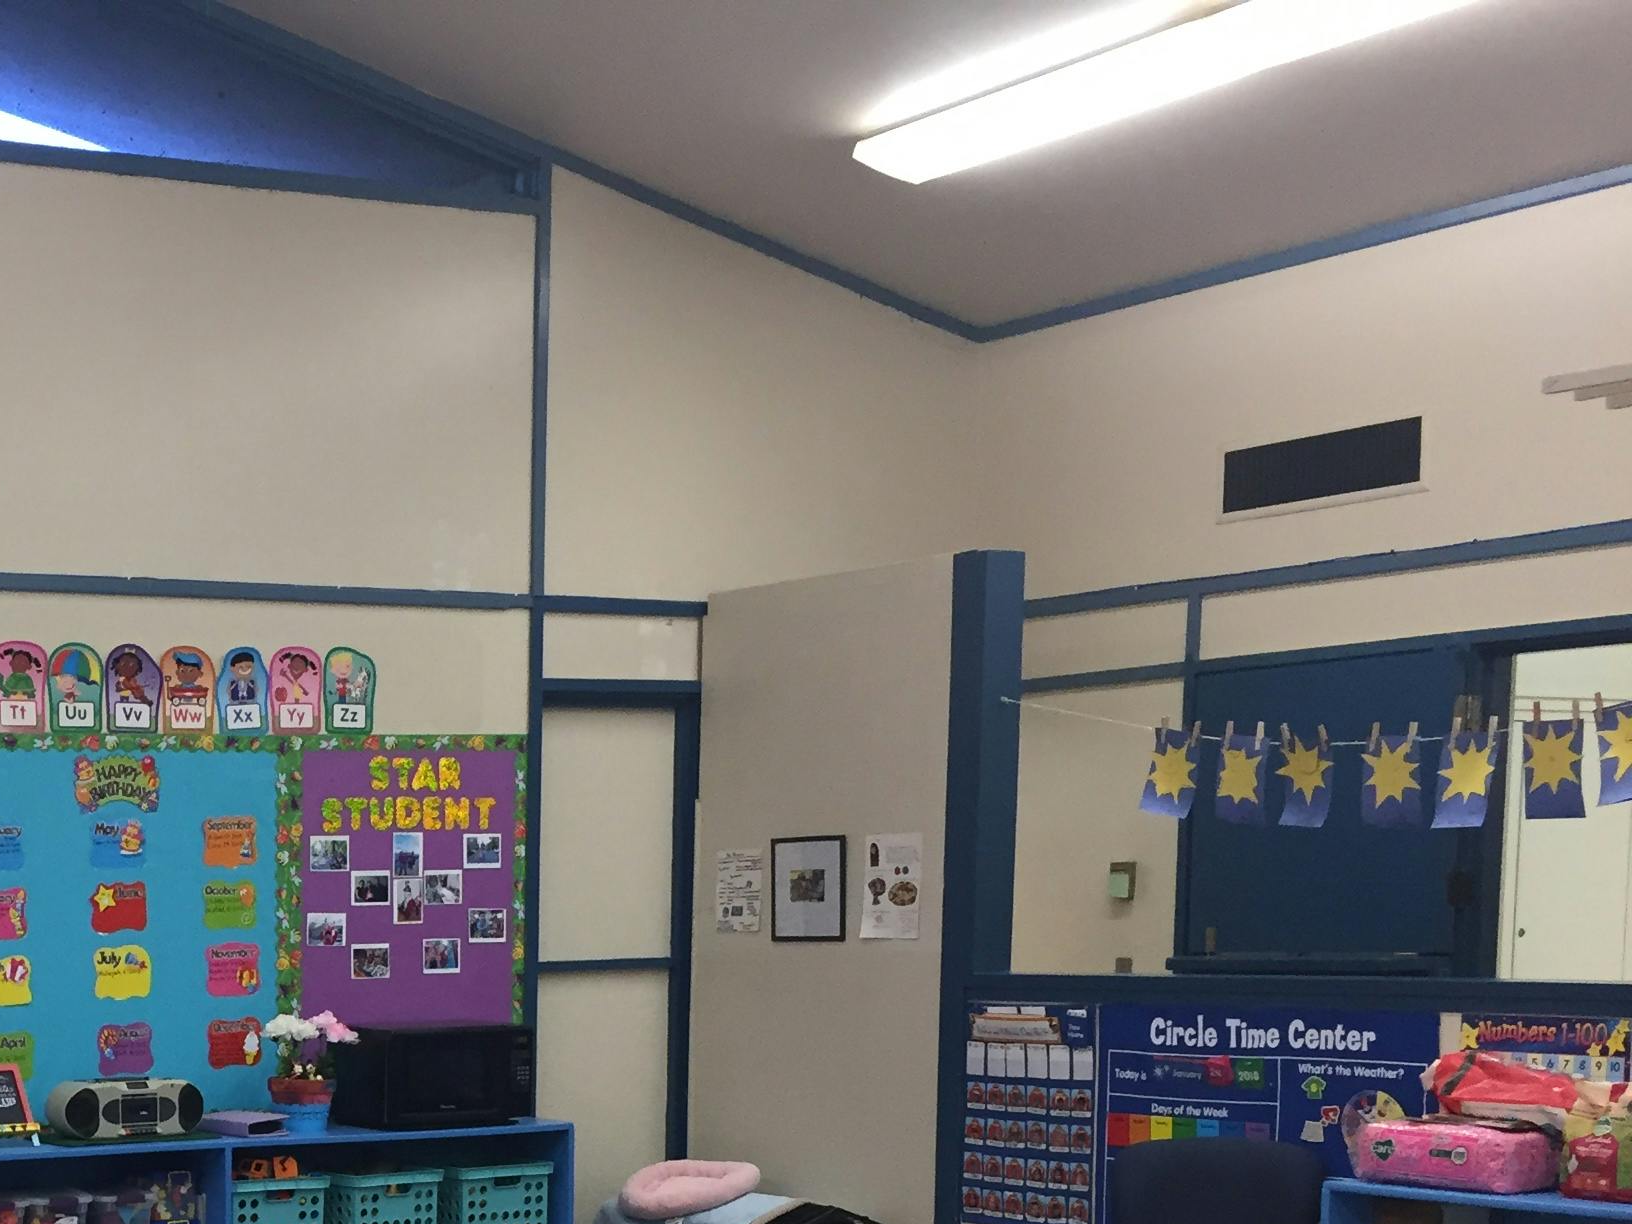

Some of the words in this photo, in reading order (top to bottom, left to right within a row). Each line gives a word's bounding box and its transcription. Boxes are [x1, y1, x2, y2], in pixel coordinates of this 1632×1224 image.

[10, 707, 28, 721] Tt
[65, 704, 88, 720] Uu
[122, 708, 143, 722] Vv
[172, 709, 203, 723] Ww
[233, 709, 253, 722] Xx
[287, 710, 306, 726] Yy
[340, 708, 359, 722] Zz
[95, 764, 141, 782] HAPPY
[368, 755, 462, 792] STAR
[90, 781, 151, 801] BIRTHDAY
[321, 795, 497, 832] STUDENT
[94, 822, 120, 837] May
[207, 821, 253, 831] September
[204, 886, 237, 895] October
[96, 951, 121, 969] July
[1149, 1014, 1219, 1048] Circle
[1226, 1018, 1280, 1050] Time
[1288, 1019, 1376, 1052] Center
[1479, 1021, 1557, 1043] Numbers
[1561, 1023, 1608, 1045] 1-100
[1298, 1063, 1333, 1075] What's
[1335, 1064, 1352, 1076] the
[1353, 1065, 1405, 1080] Weather?
[1562, 1060, 1570, 1069] 7
[1579, 1060, 1586, 1070] 8
[1595, 1060, 1602, 1071] 9
[1610, 1061, 1621, 1073] 10
[1115, 1068, 1140, 1082] Today
[1172, 1069, 1202, 1081] January
[1151, 1103, 1173, 1115] Days
[1174, 1104, 1184, 1115] of
[1186, 1105, 1201, 1116] the
[1203, 1107, 1229, 1119] Week
